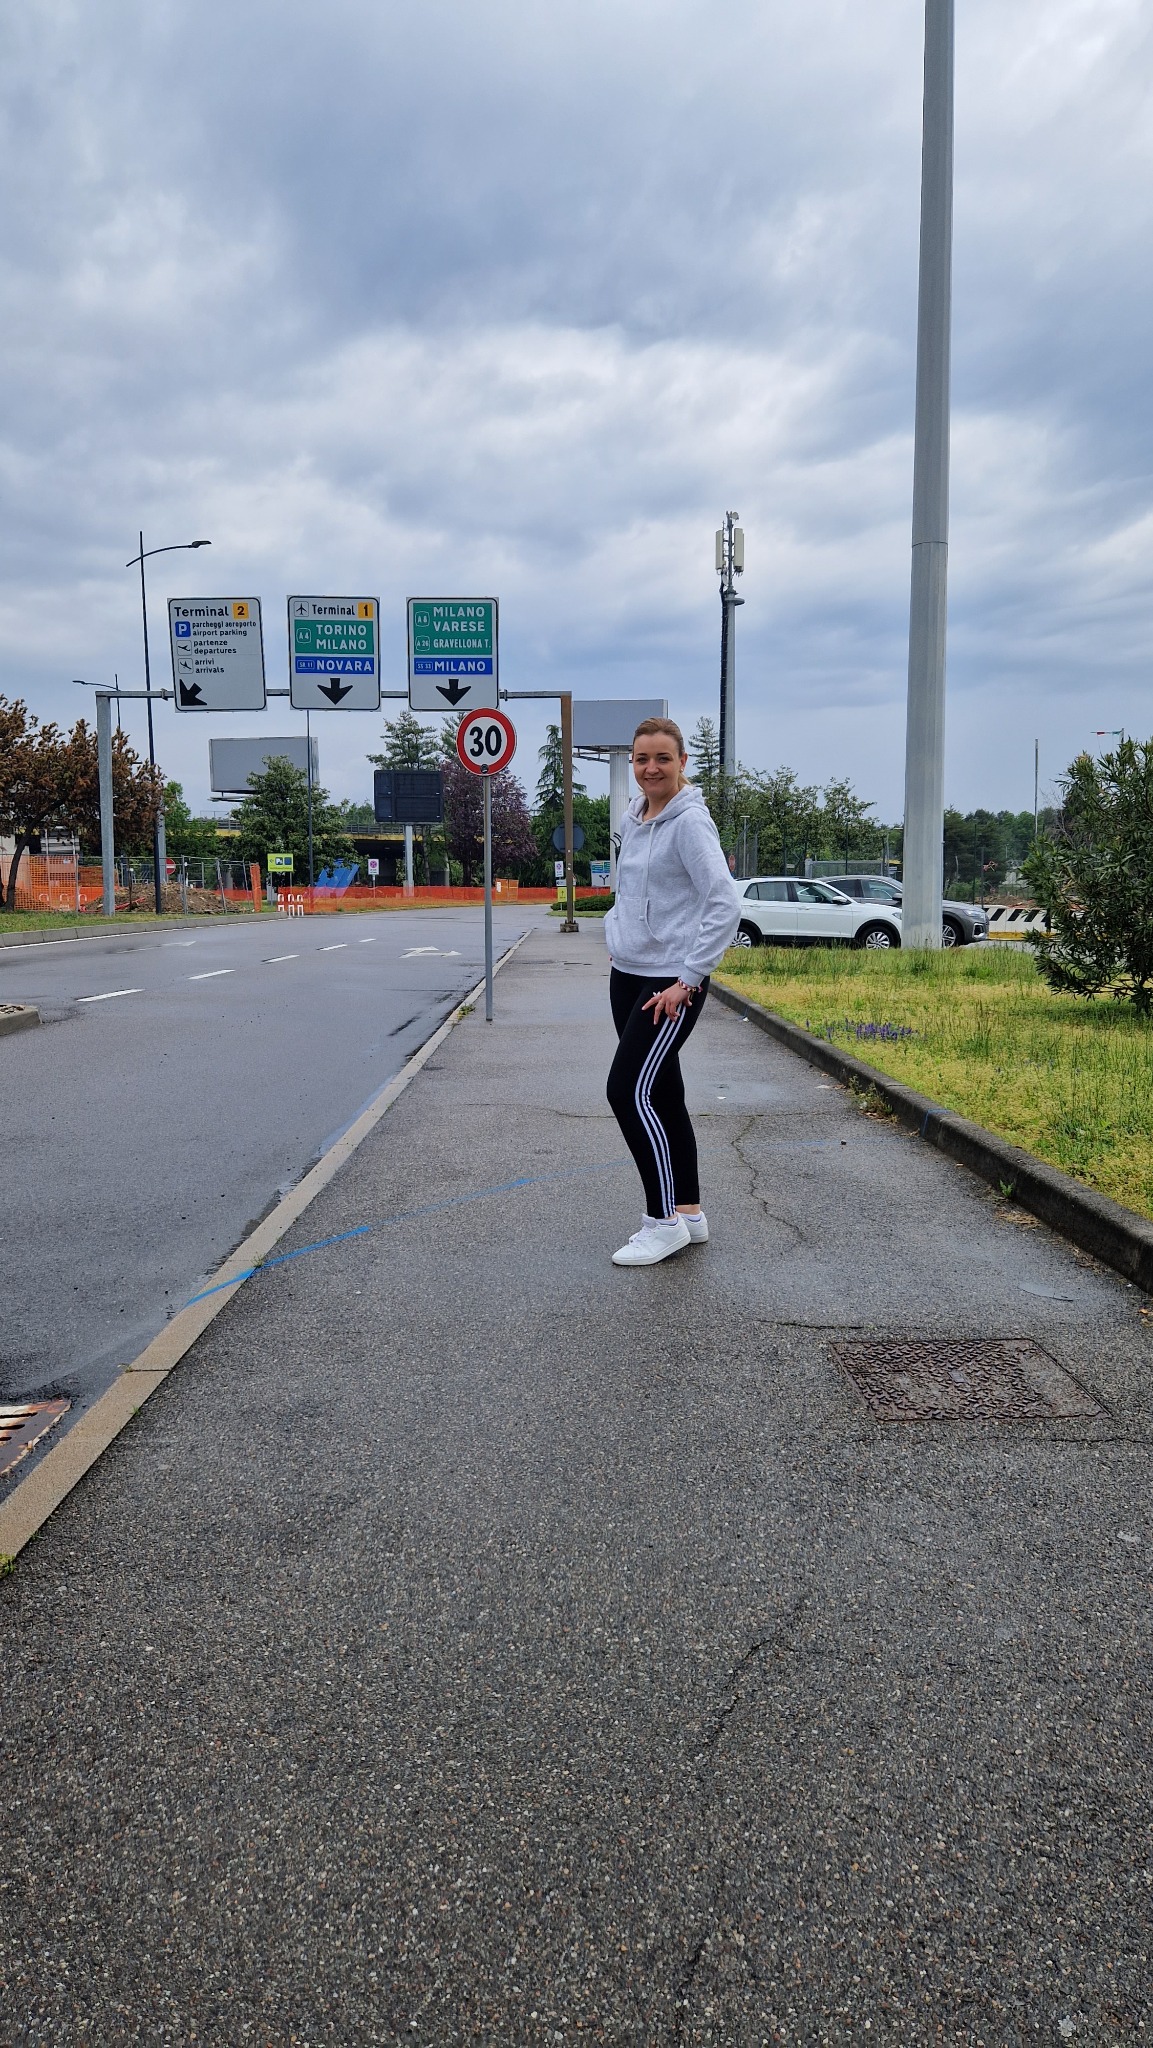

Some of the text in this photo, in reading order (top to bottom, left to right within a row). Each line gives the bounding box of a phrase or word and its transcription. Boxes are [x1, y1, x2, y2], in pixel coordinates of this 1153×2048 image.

[174, 606, 245, 617] Terminal 2
[312, 604, 356, 616] Terminal
[433, 607, 485, 618] MILANO
[178, 623, 187, 635] P
[316, 625, 366, 636] TORINO
[433, 621, 485, 632] VARESE
[192, 629, 217, 637] airport
[316, 639, 367, 650] MILANO
[433, 639, 491, 648] GRAVELLONA T.
[194, 647, 237, 655] departures
[317, 660, 372, 671] NOVARA
[435, 661, 486, 672] MILANO
[470, 725, 502, 757] 30
